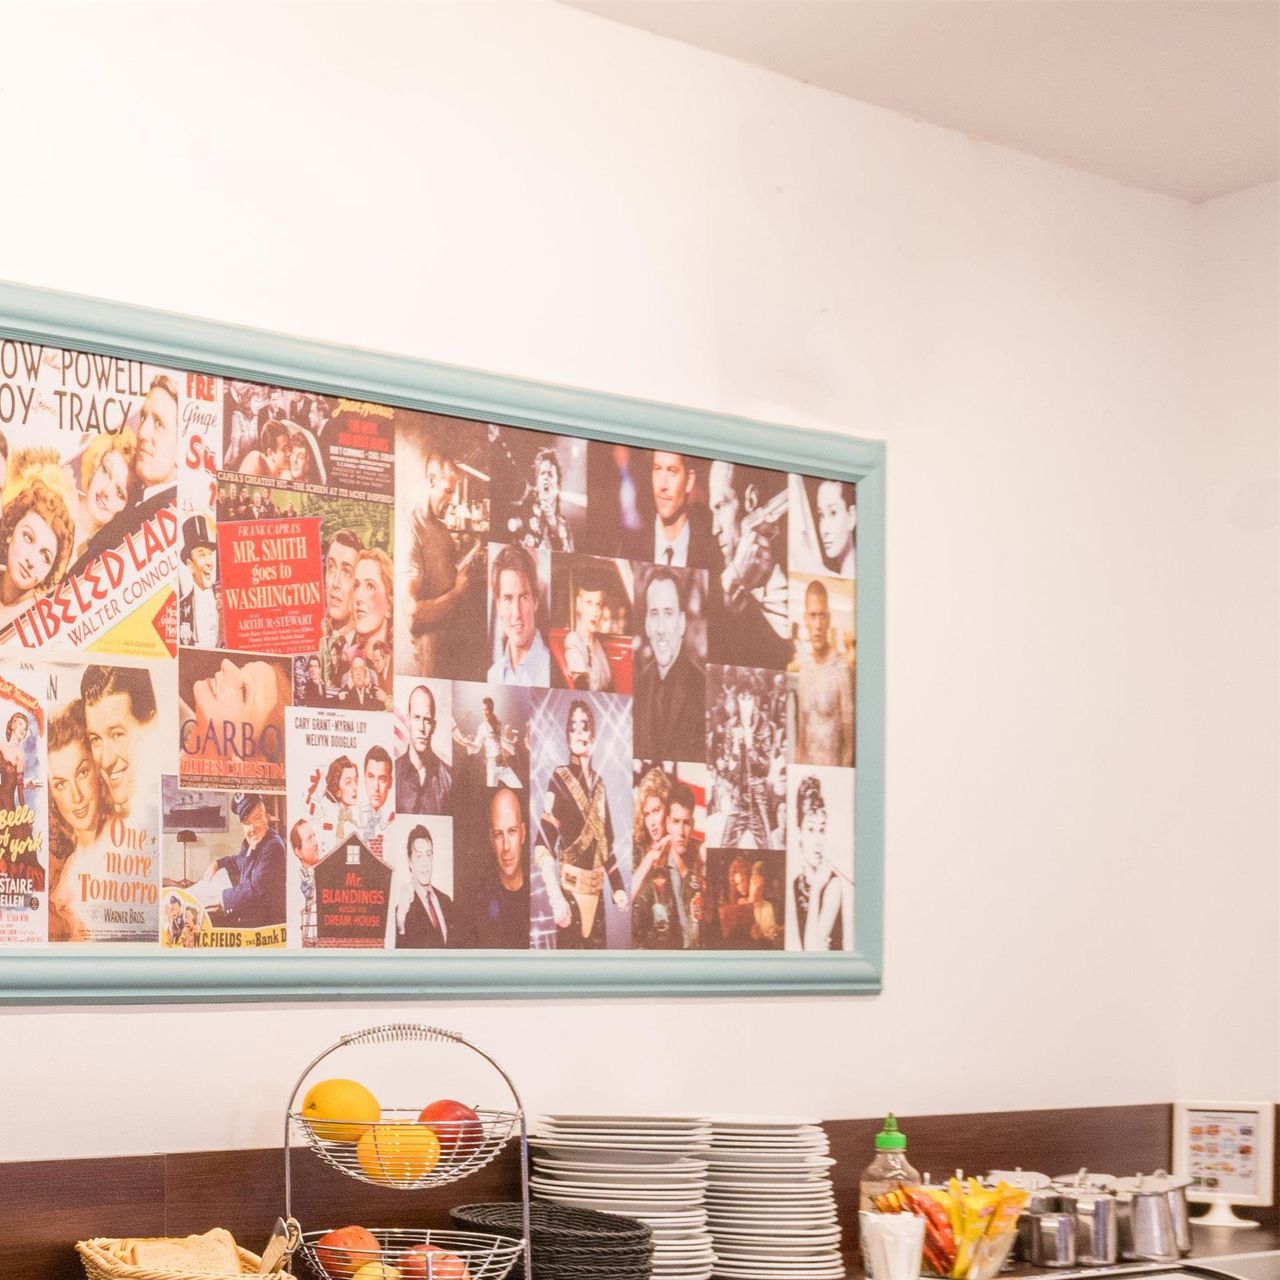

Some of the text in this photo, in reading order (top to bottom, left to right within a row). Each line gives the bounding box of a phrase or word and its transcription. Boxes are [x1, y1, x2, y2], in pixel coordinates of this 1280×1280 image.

[62, 349, 150, 397] POWELL
[186, 373, 216, 402] FRE
[54, 390, 133, 435] TRACY
[182, 401, 217, 437] Ginge
[233, 537, 307, 563] MR. SMITH
[252, 563, 292, 584] goes to
[13, 549, 125, 648] LIBELED
[67, 599, 121, 647] WALTER
[123, 551, 178, 605] CONNOL
[225, 582, 321, 610] WASHINGTON
[20, 663, 34, 671] ANN
[180, 718, 282, 760] GARBO
[295, 717, 368, 734] CARY LOY
[306, 734, 357, 749] MELVYN DOUGLAS
[0, 827, 10, 846] of
[9, 831, 43, 862] York
[110, 819, 147, 851] One
[105, 852, 151, 878] more
[322, 888, 385, 904] BLANDINGS
[325, 914, 380, 927] DREAM HOUSE
[256, 929, 278, 947] Bank
